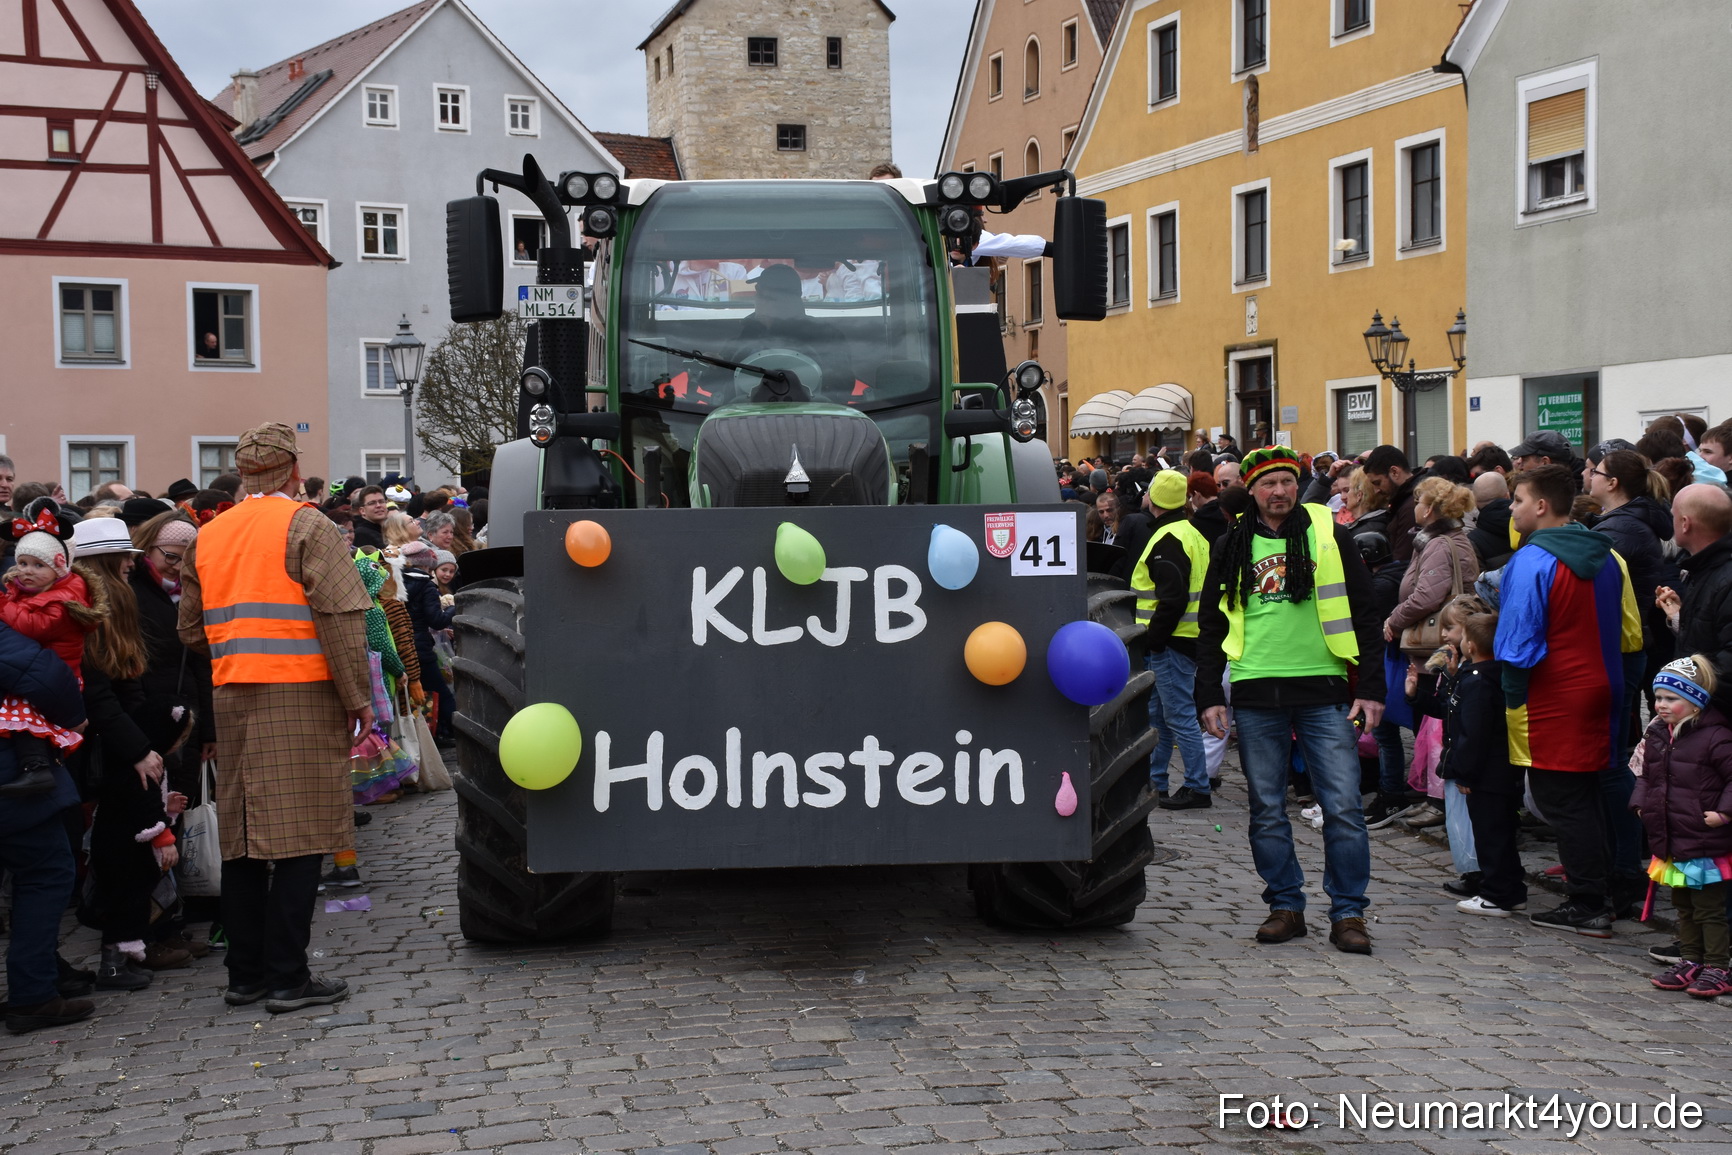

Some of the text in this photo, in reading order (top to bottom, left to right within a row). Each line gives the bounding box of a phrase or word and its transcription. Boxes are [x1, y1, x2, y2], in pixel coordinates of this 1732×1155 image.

[534, 288, 553, 301] NM
[525, 303, 576, 316] ML 514
[1348, 393, 1371, 410] BW
[1538, 394, 1582, 406] ZU VERMIETEN
[1347, 411, 1372, 420] Bekleidung
[1019, 535, 1066, 567] 41
[691, 564, 927, 647] KLJB
[1673, 681, 1703, 701] TSV
[593, 726, 1025, 812] Holnstein
